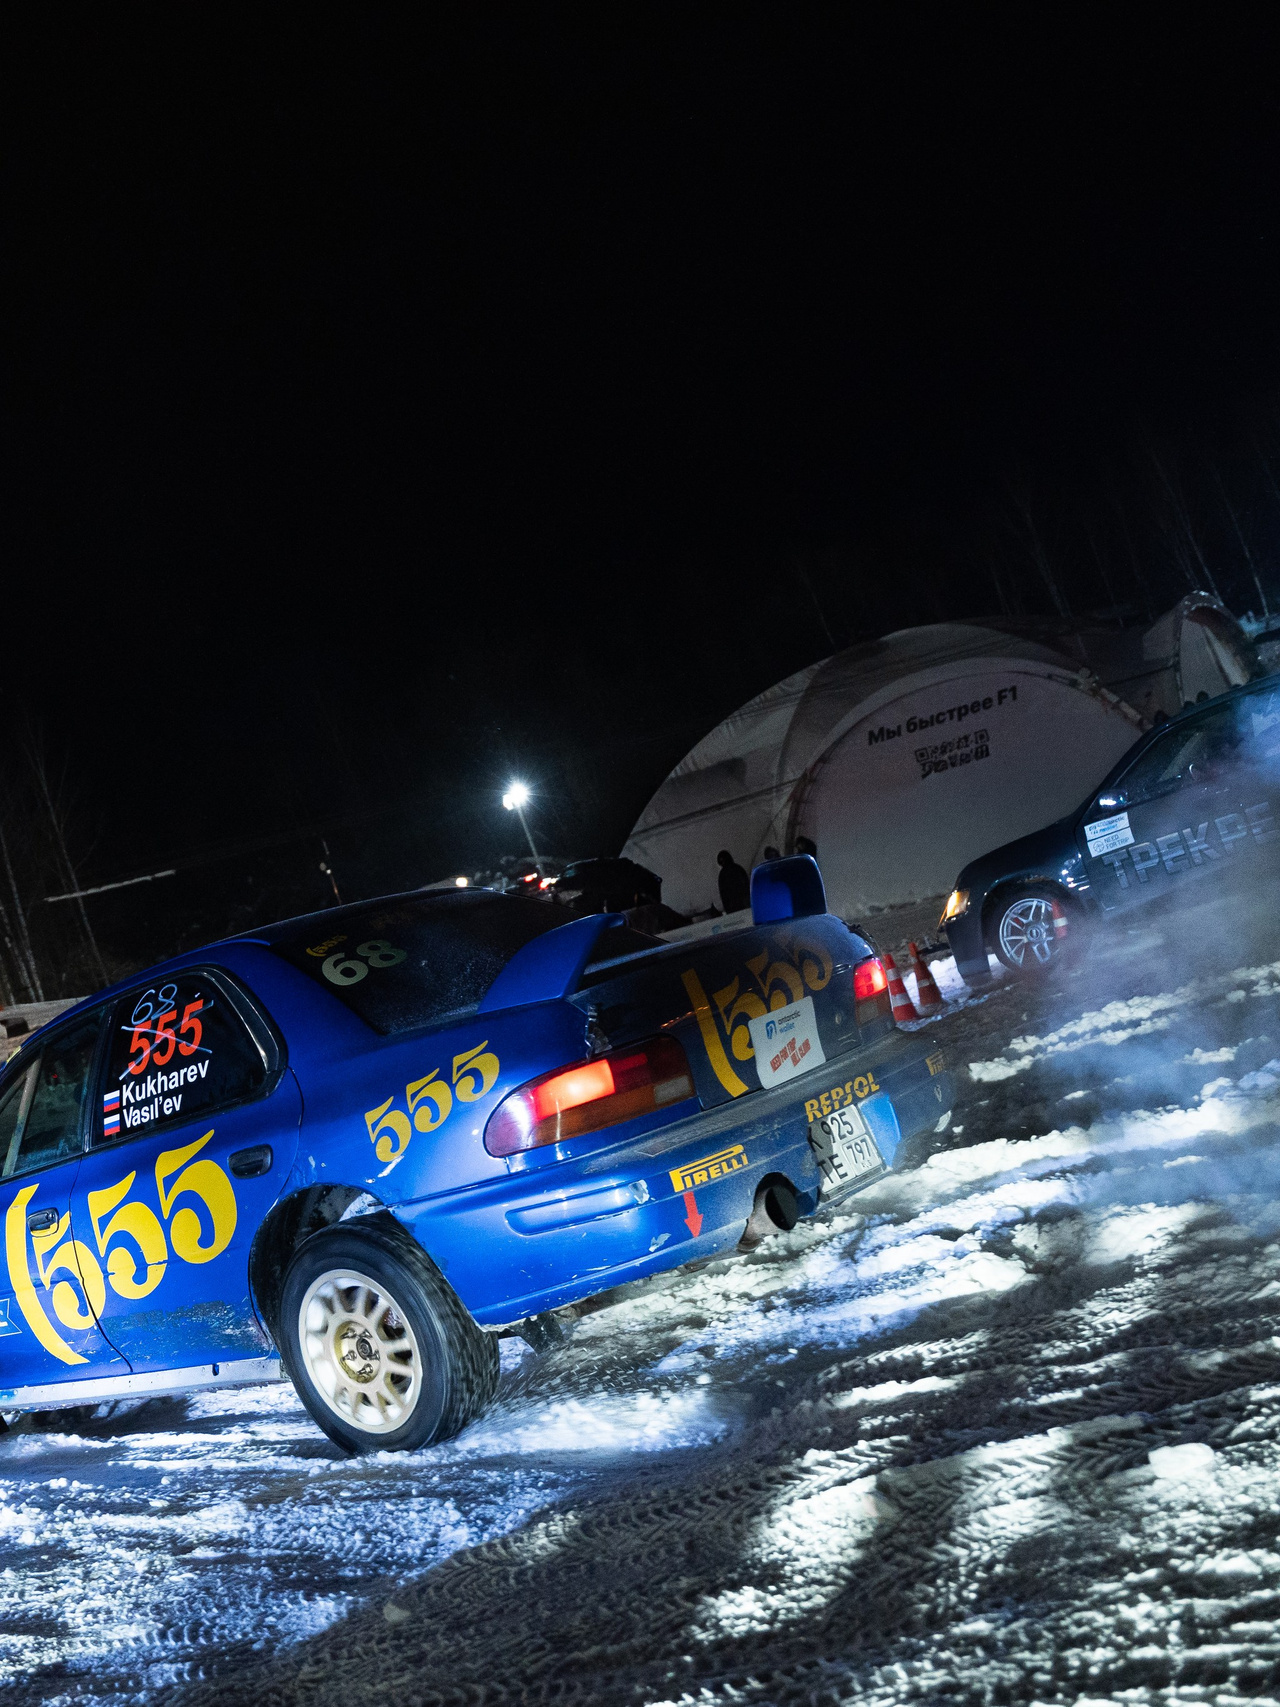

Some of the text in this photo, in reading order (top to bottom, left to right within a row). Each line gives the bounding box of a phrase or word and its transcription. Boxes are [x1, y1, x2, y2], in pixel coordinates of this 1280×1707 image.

[868, 685, 1018, 746] Мы быстрее F1
[322, 940, 408, 986] 68
[131, 983, 177, 1025] 68
[127, 999, 204, 1075] 555
[122, 1060, 209, 1107] Kukharev
[364, 1039, 500, 1163] 555
[804, 1072, 880, 1123] REPSOL
[669, 1144, 748, 1192] PIRELLI
[846, 1138, 872, 1165] 797
